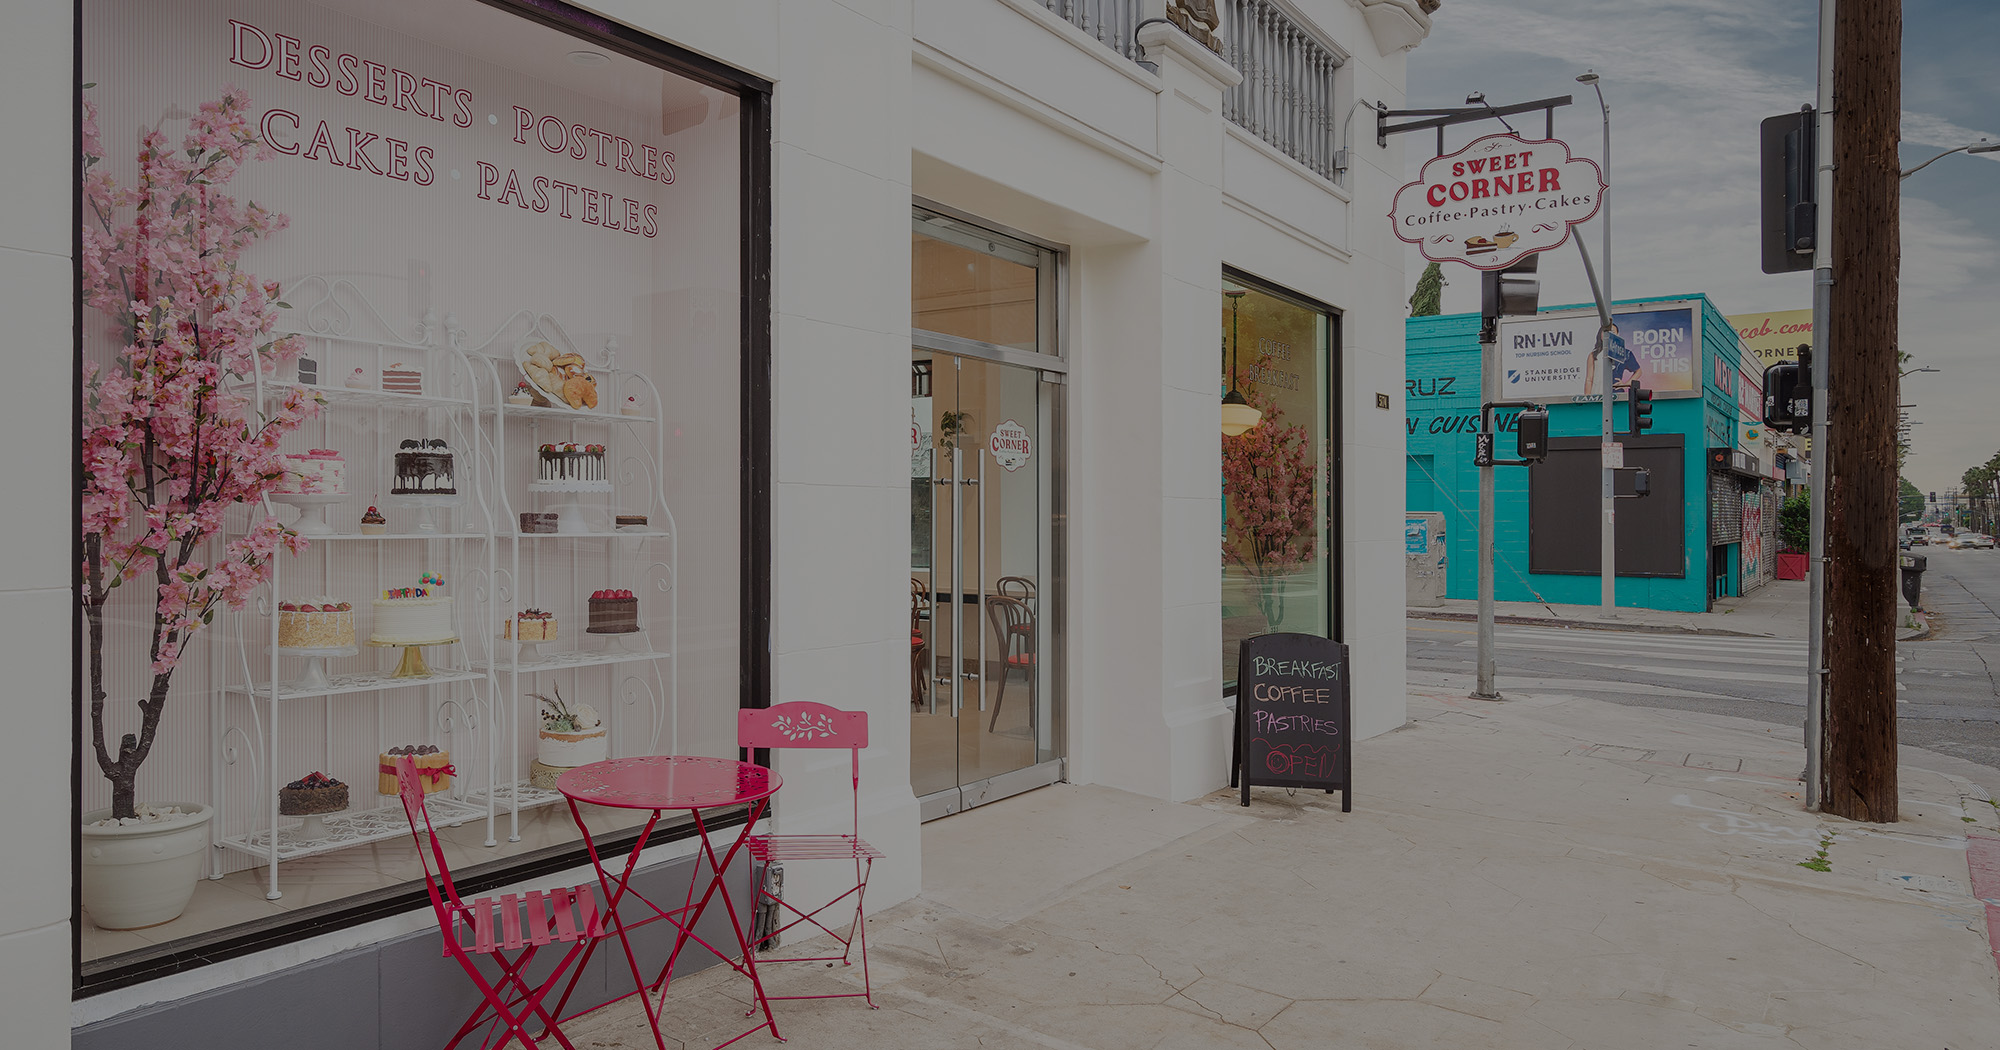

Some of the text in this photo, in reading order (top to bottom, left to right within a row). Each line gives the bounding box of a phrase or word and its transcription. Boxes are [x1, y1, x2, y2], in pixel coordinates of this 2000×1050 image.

[229, 19, 676, 185] DESSERTS POSTRES
[260, 108, 658, 239] CAKES PASTELES
[1452, 151, 1533, 177] SWEET
[1426, 167, 1561, 208] CORNER
[1632, 327, 1684, 345] BORN
[1735, 317, 1813, 339] cob.com
[1258, 337, 1291, 362] COFFEE
[1640, 343, 1677, 360] FOR
[1524, 367, 1580, 376] STANBRIDGE
[1650, 357, 1690, 374] THIS
[1249, 364, 1300, 391] BREAKFAST
[1000, 429, 1022, 439] SWEET
[1429, 412, 1519, 434] CUISNE
[992, 436, 1029, 454] CORNER
[1252, 656, 1342, 681] BREAKFAST
[1253, 682, 1330, 704] COFFEE
[1252, 709, 1339, 736] PASTRIES
[1266, 750, 1337, 778] OPEN
